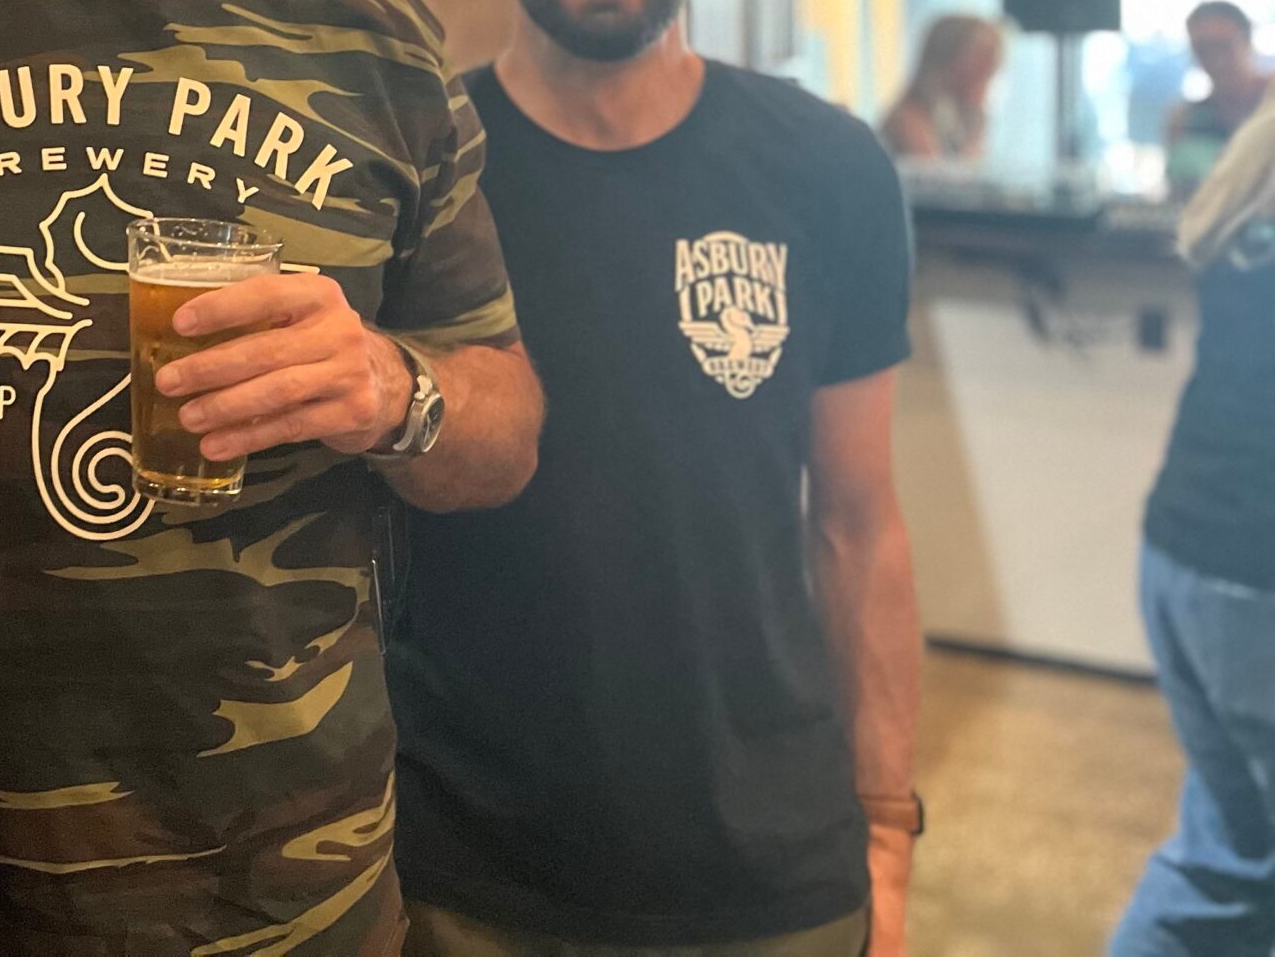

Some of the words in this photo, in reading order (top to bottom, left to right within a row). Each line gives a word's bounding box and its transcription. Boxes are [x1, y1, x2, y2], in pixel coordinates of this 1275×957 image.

[168, 77, 353, 210] PARK
[675, 239, 788, 292] ASBURY
[695, 276, 776, 321] PARK
